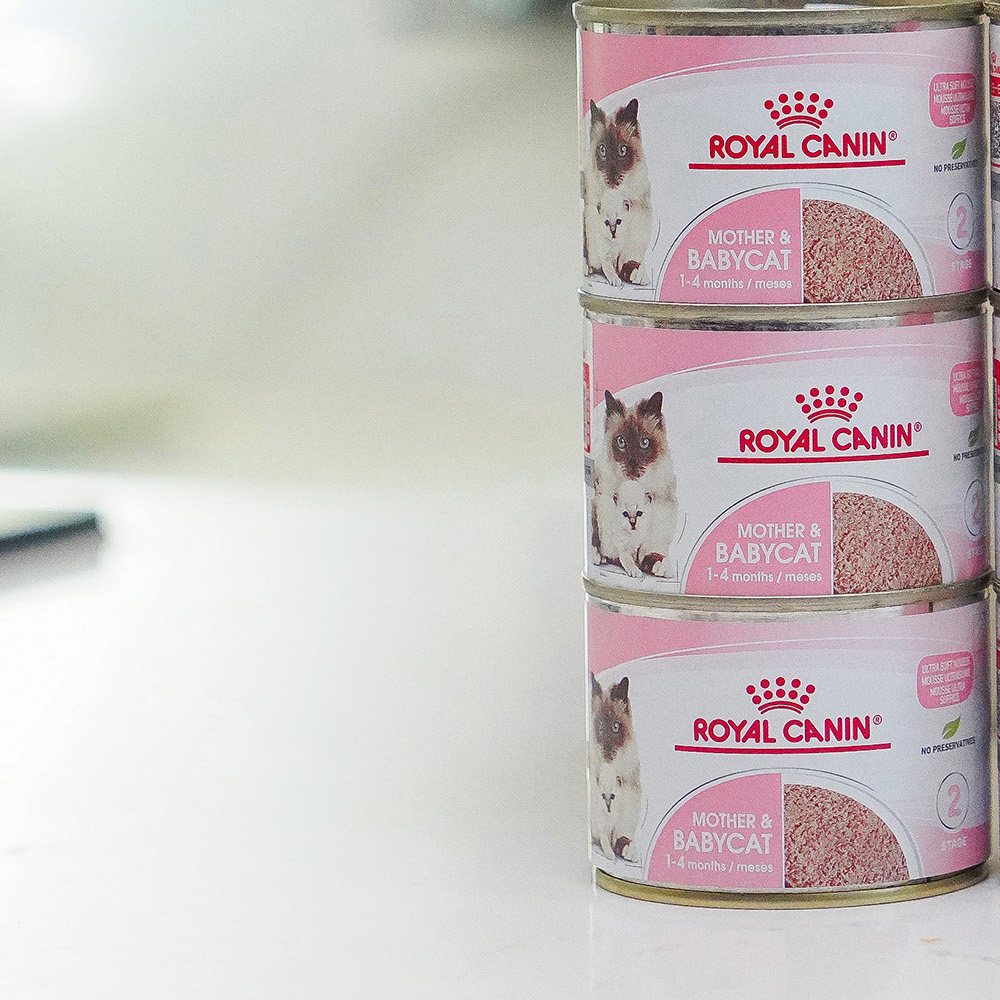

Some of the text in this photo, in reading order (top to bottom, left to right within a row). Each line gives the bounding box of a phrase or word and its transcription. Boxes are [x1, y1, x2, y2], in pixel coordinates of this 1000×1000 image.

[710, 135, 795, 159] ROYAL
[933, 164, 943, 173] NO
[956, 205, 967, 239] 2
[708, 229, 791, 246] MOTHER &
[688, 248, 792, 271] BABYCAT
[679, 273, 701, 288] 1-4
[703, 277, 744, 289] months
[754, 279, 793, 290] meses
[740, 429, 825, 452] ROYAL
[737, 522, 821, 539] MOTHER &
[716, 542, 822, 564] BABYCAT
[707, 566, 729, 582] 1-4
[731, 570, 774, 583] months
[784, 572, 823, 582] meses
[694, 719, 776, 743] ROYAL
[921, 736, 976, 755] NO PRESERVATIVES
[947, 784, 962, 818] 2
[692, 811, 773, 829] MOTHER &
[673, 829, 773, 855] BABYCAT
[666, 853, 685, 869] 1-4
[687, 859, 727, 872] months
[736, 863, 774, 873] meses
